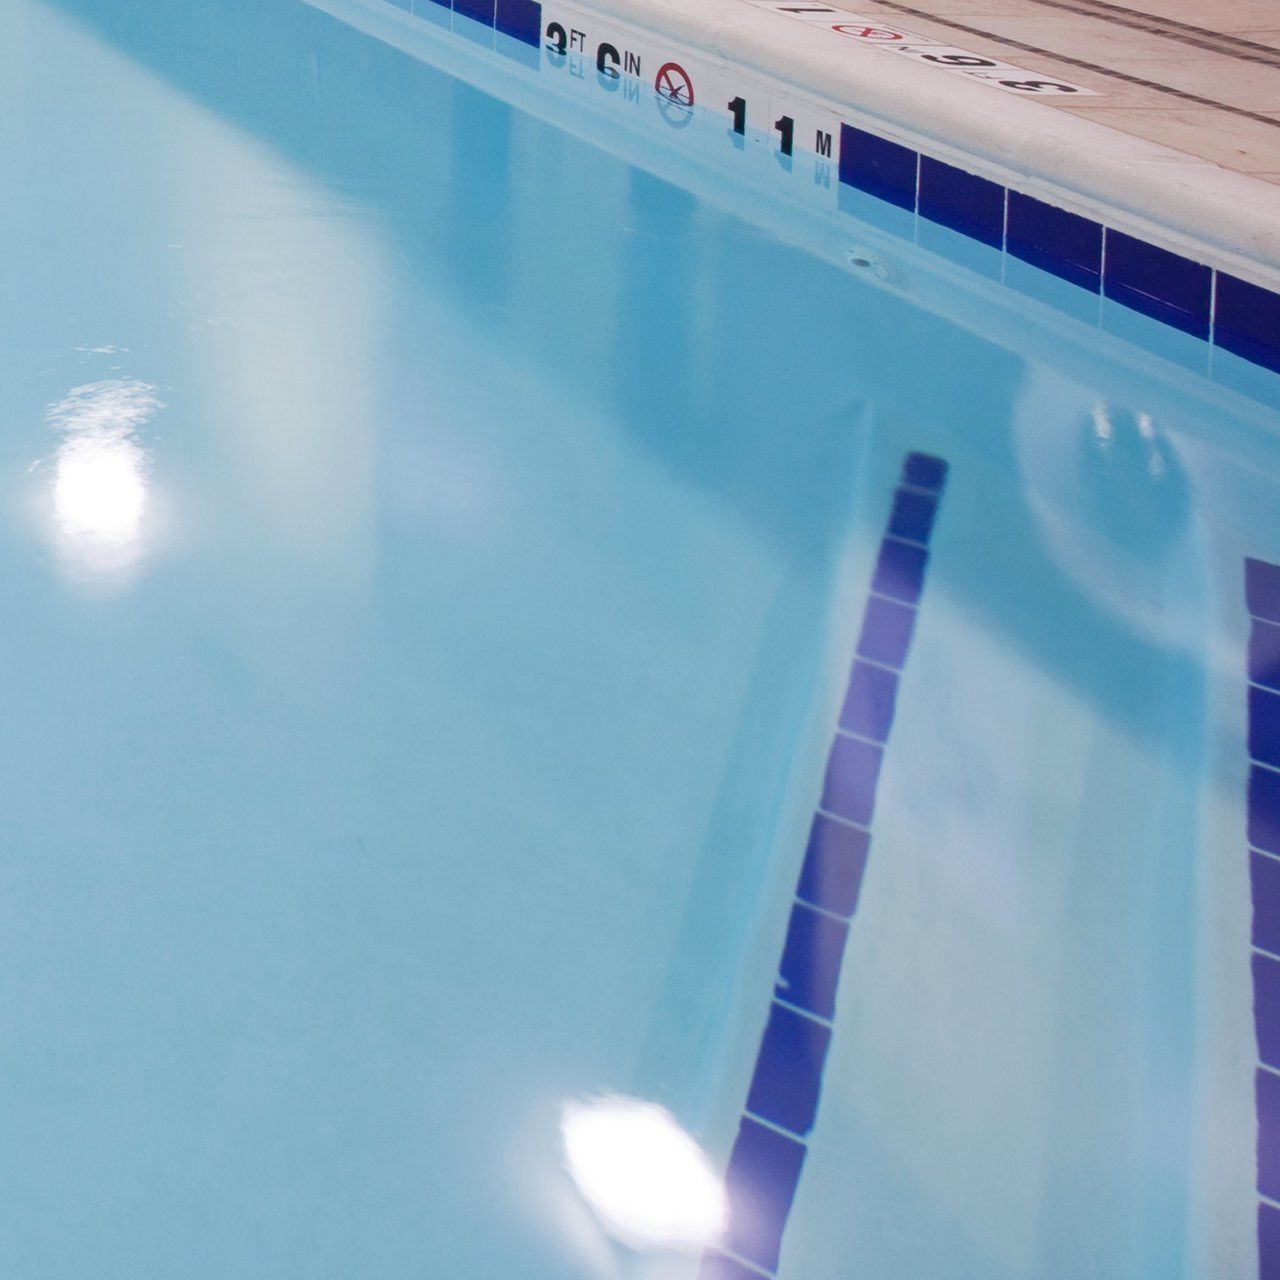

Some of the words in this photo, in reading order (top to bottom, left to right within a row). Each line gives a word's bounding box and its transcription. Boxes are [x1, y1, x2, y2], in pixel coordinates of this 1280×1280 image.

[545, 21, 567, 56] 3
[570, 28, 586, 53] FT
[596, 42, 620, 80] 6
[624, 50, 641, 78] IN
[815, 129, 832, 159] M
